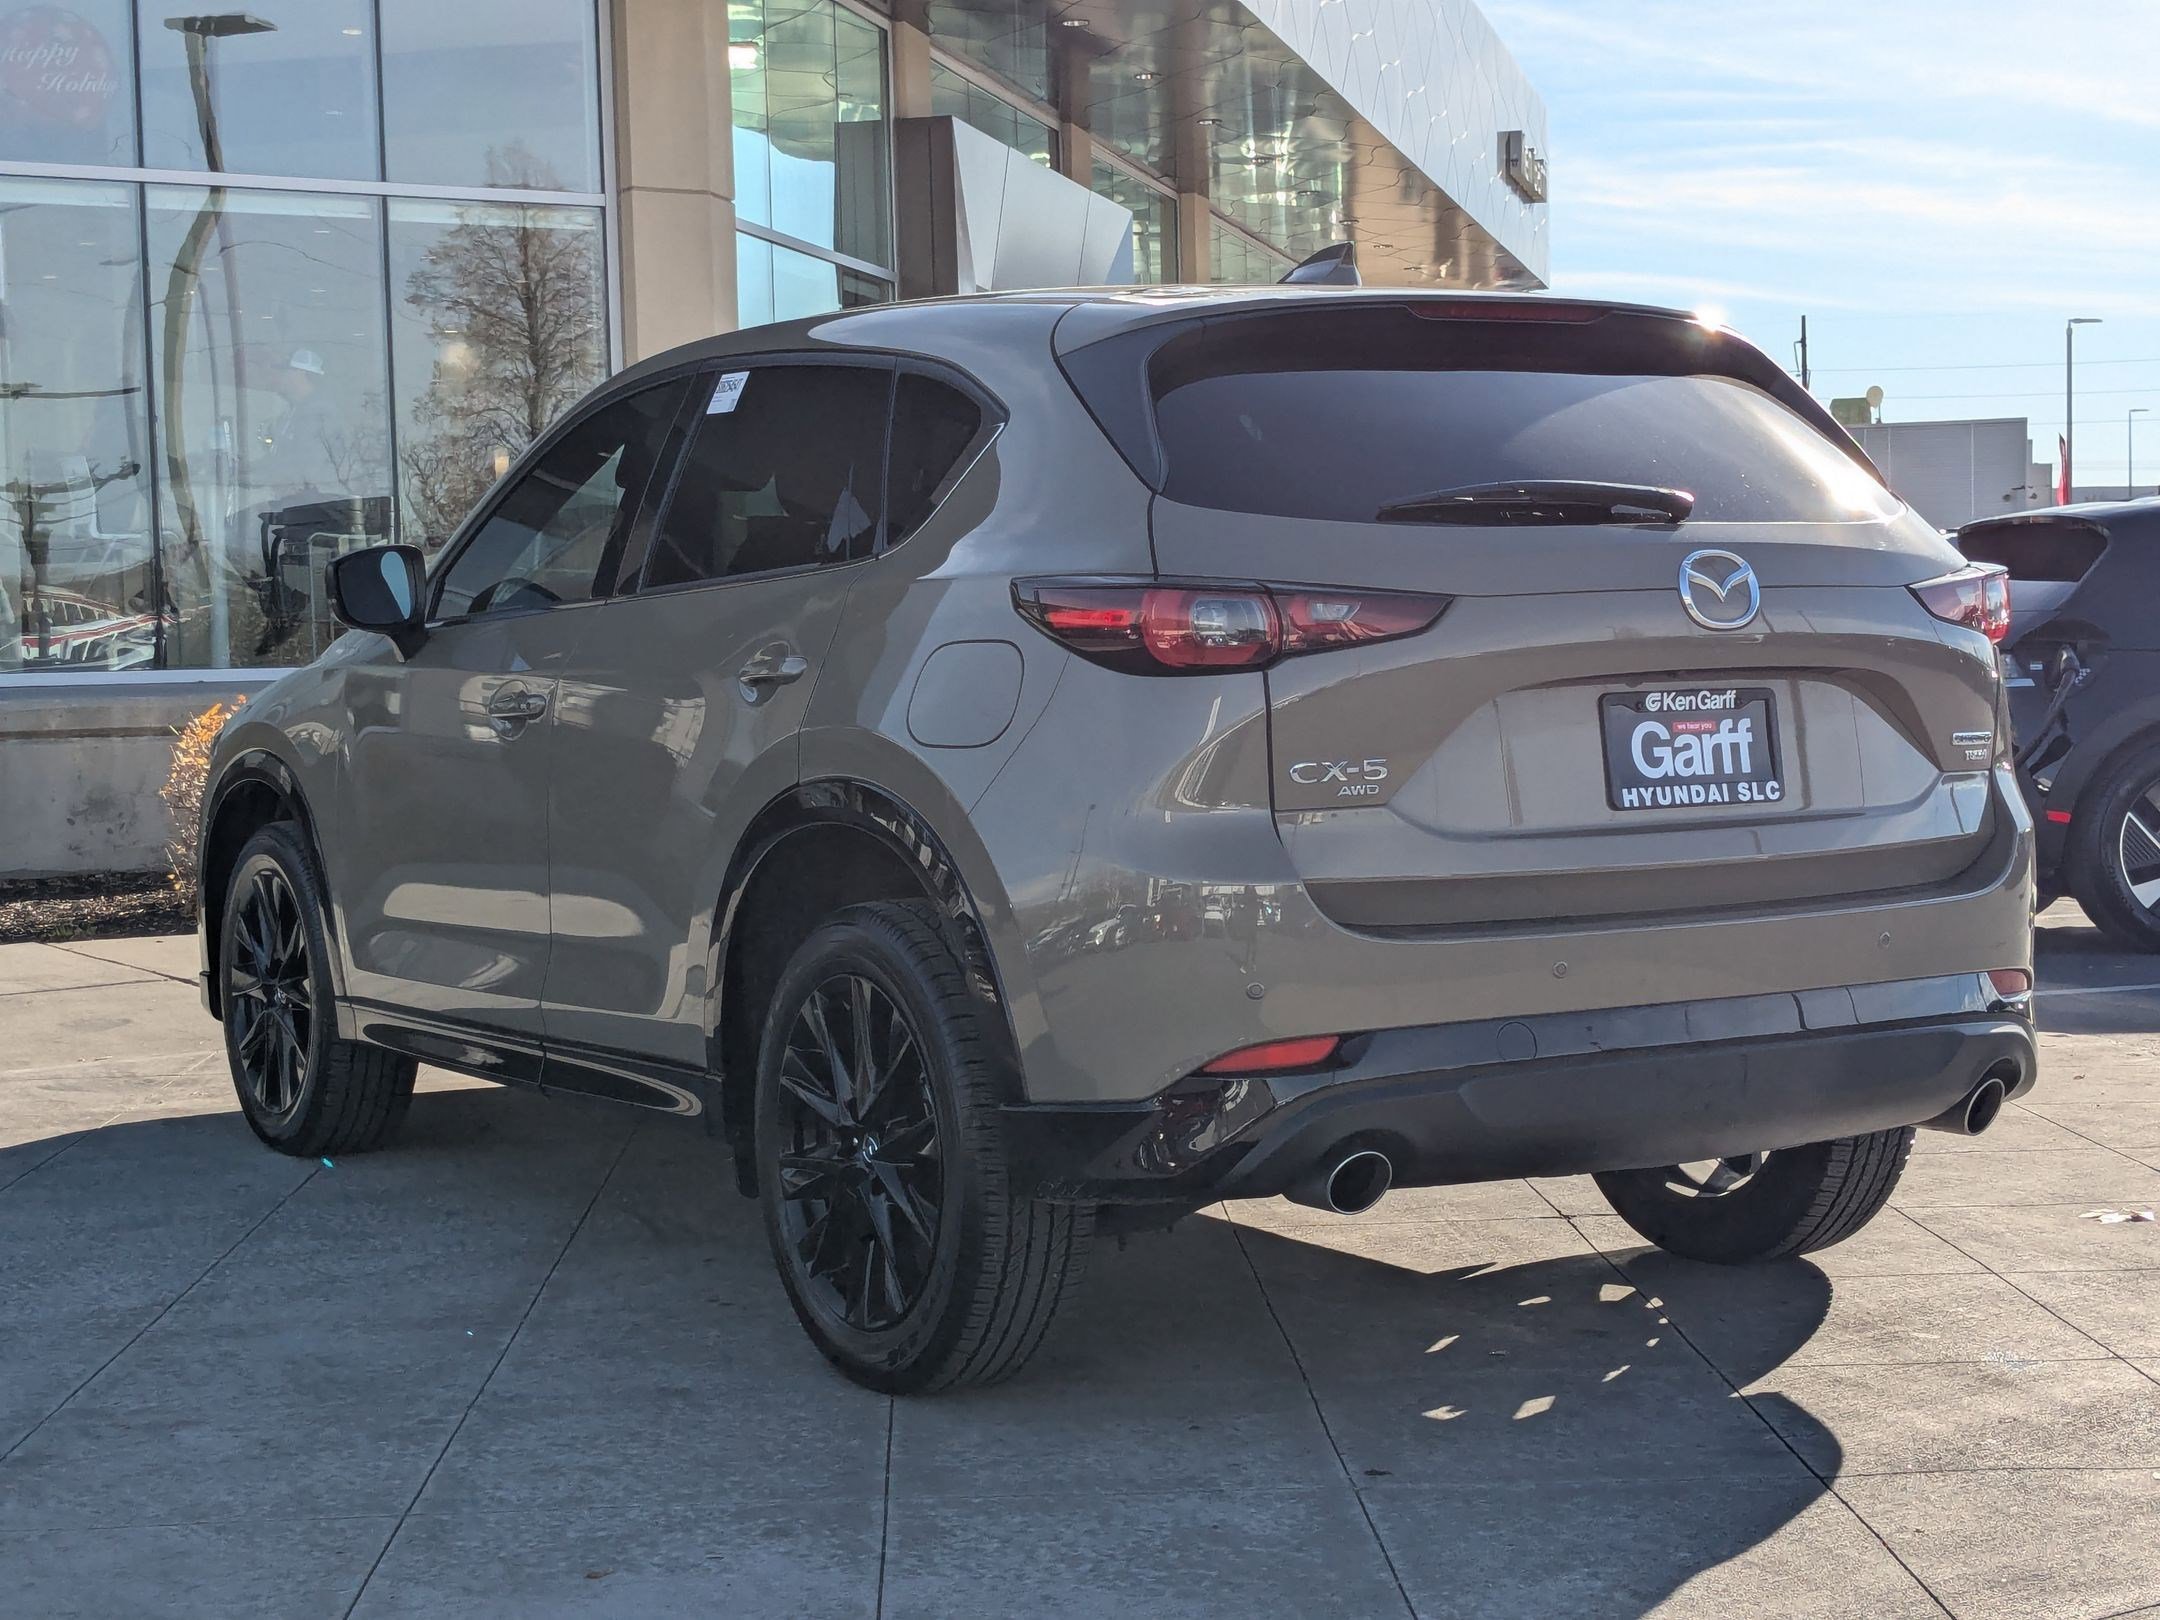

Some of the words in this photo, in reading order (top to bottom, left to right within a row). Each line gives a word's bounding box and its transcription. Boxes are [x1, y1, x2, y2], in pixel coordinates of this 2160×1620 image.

[1631, 718, 1753, 779] Garff
[1289, 759, 1388, 784] CX-5
[1337, 784, 1380, 797] AWD
[1622, 783, 1730, 808] HYUNDAI
[1737, 780, 1781, 801] SLC
